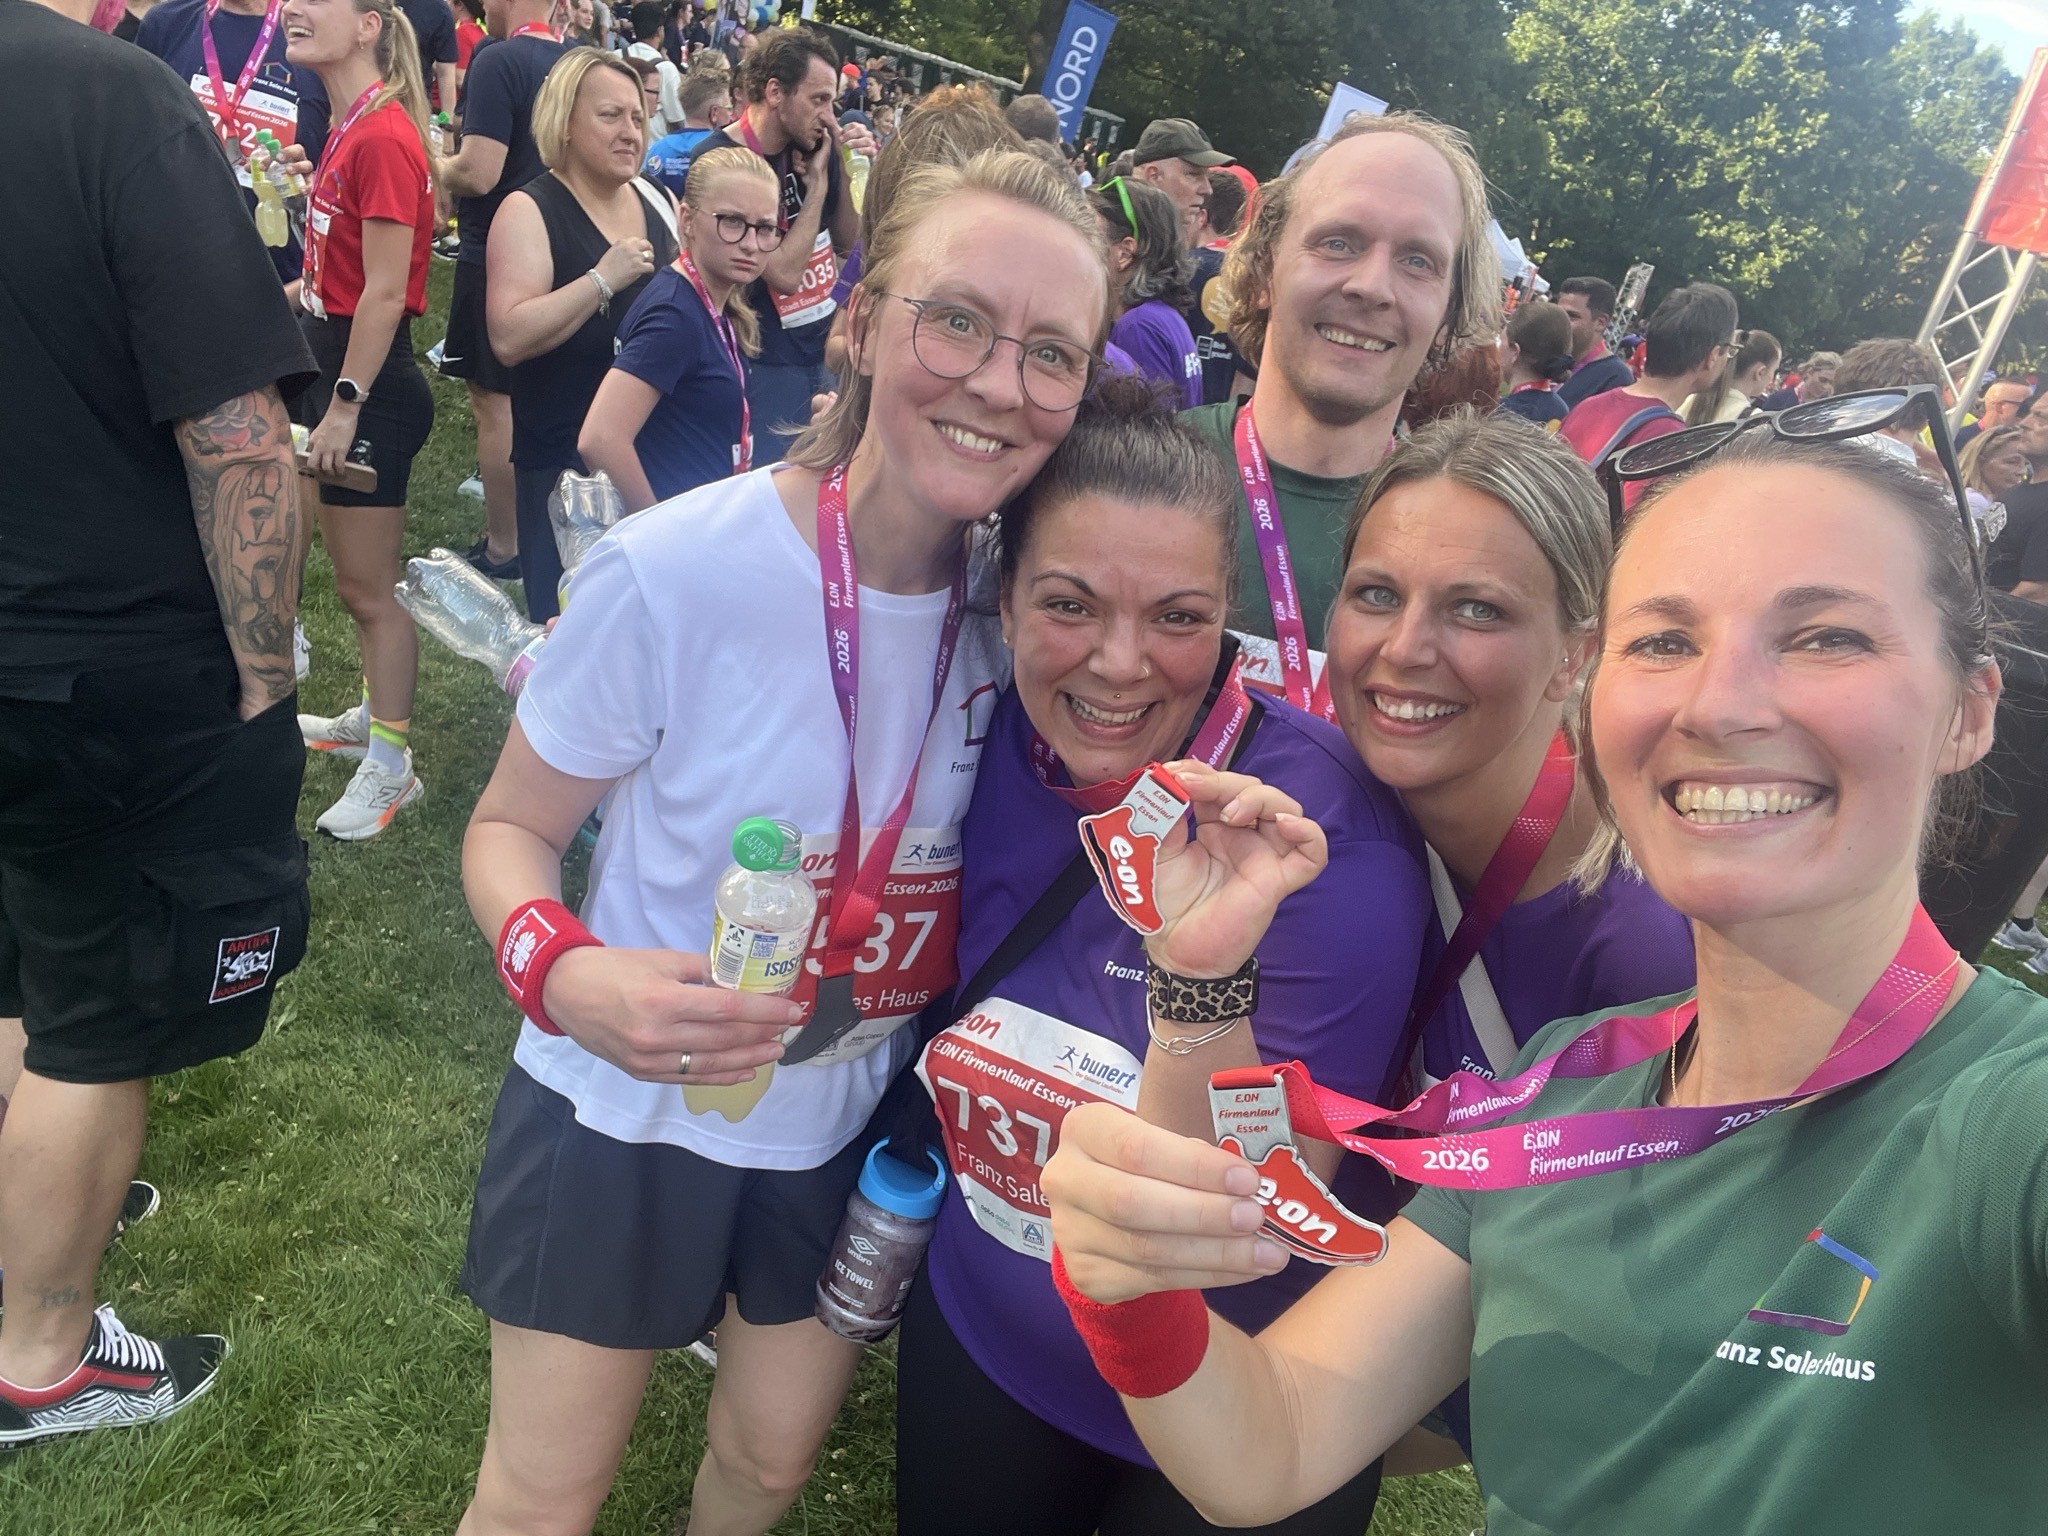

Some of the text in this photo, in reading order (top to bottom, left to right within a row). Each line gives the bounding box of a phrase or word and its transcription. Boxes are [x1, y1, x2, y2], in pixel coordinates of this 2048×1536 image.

[1050, 26, 1098, 128] NORD
[1255, 498, 1274, 531] 2026
[837, 511, 854, 608] Firmenlauf Essen
[829, 581, 840, 608] E.ON
[1276, 544, 1297, 620] Firmenlauf Essen
[836, 629, 851, 674] 2026
[936, 644, 950, 688] 2026
[1285, 636, 1301, 672] 2026
[1208, 730, 1232, 767] enlauf
[1227, 705, 1244, 734] Essen
[950, 761, 975, 774] Franz
[801, 851, 838, 873] on
[883, 876, 960, 895] Essen 2026
[1103, 960, 1145, 982] Franz
[878, 988, 930, 1010] Haus
[933, 1038, 1077, 1110] E.ON Firmenlauf Essen
[1079, 1052, 1137, 1089] bunert
[1218, 1107, 1280, 1120] Firmenlauf
[1234, 1093, 1260, 1103] E.ON
[1236, 1123, 1268, 1134] Essen
[1523, 1129, 1561, 1151] E.ON
[1420, 1147, 1490, 1172] 2026
[1529, 1139, 1679, 1176] Firmenlauf Essen
[957, 1142, 1050, 1209] Franz Sale
[847, 1246, 873, 1266] umbro
[835, 1258, 874, 1290] ICE TOWEL
[1716, 1340, 1876, 1382] anz Sales Haus
